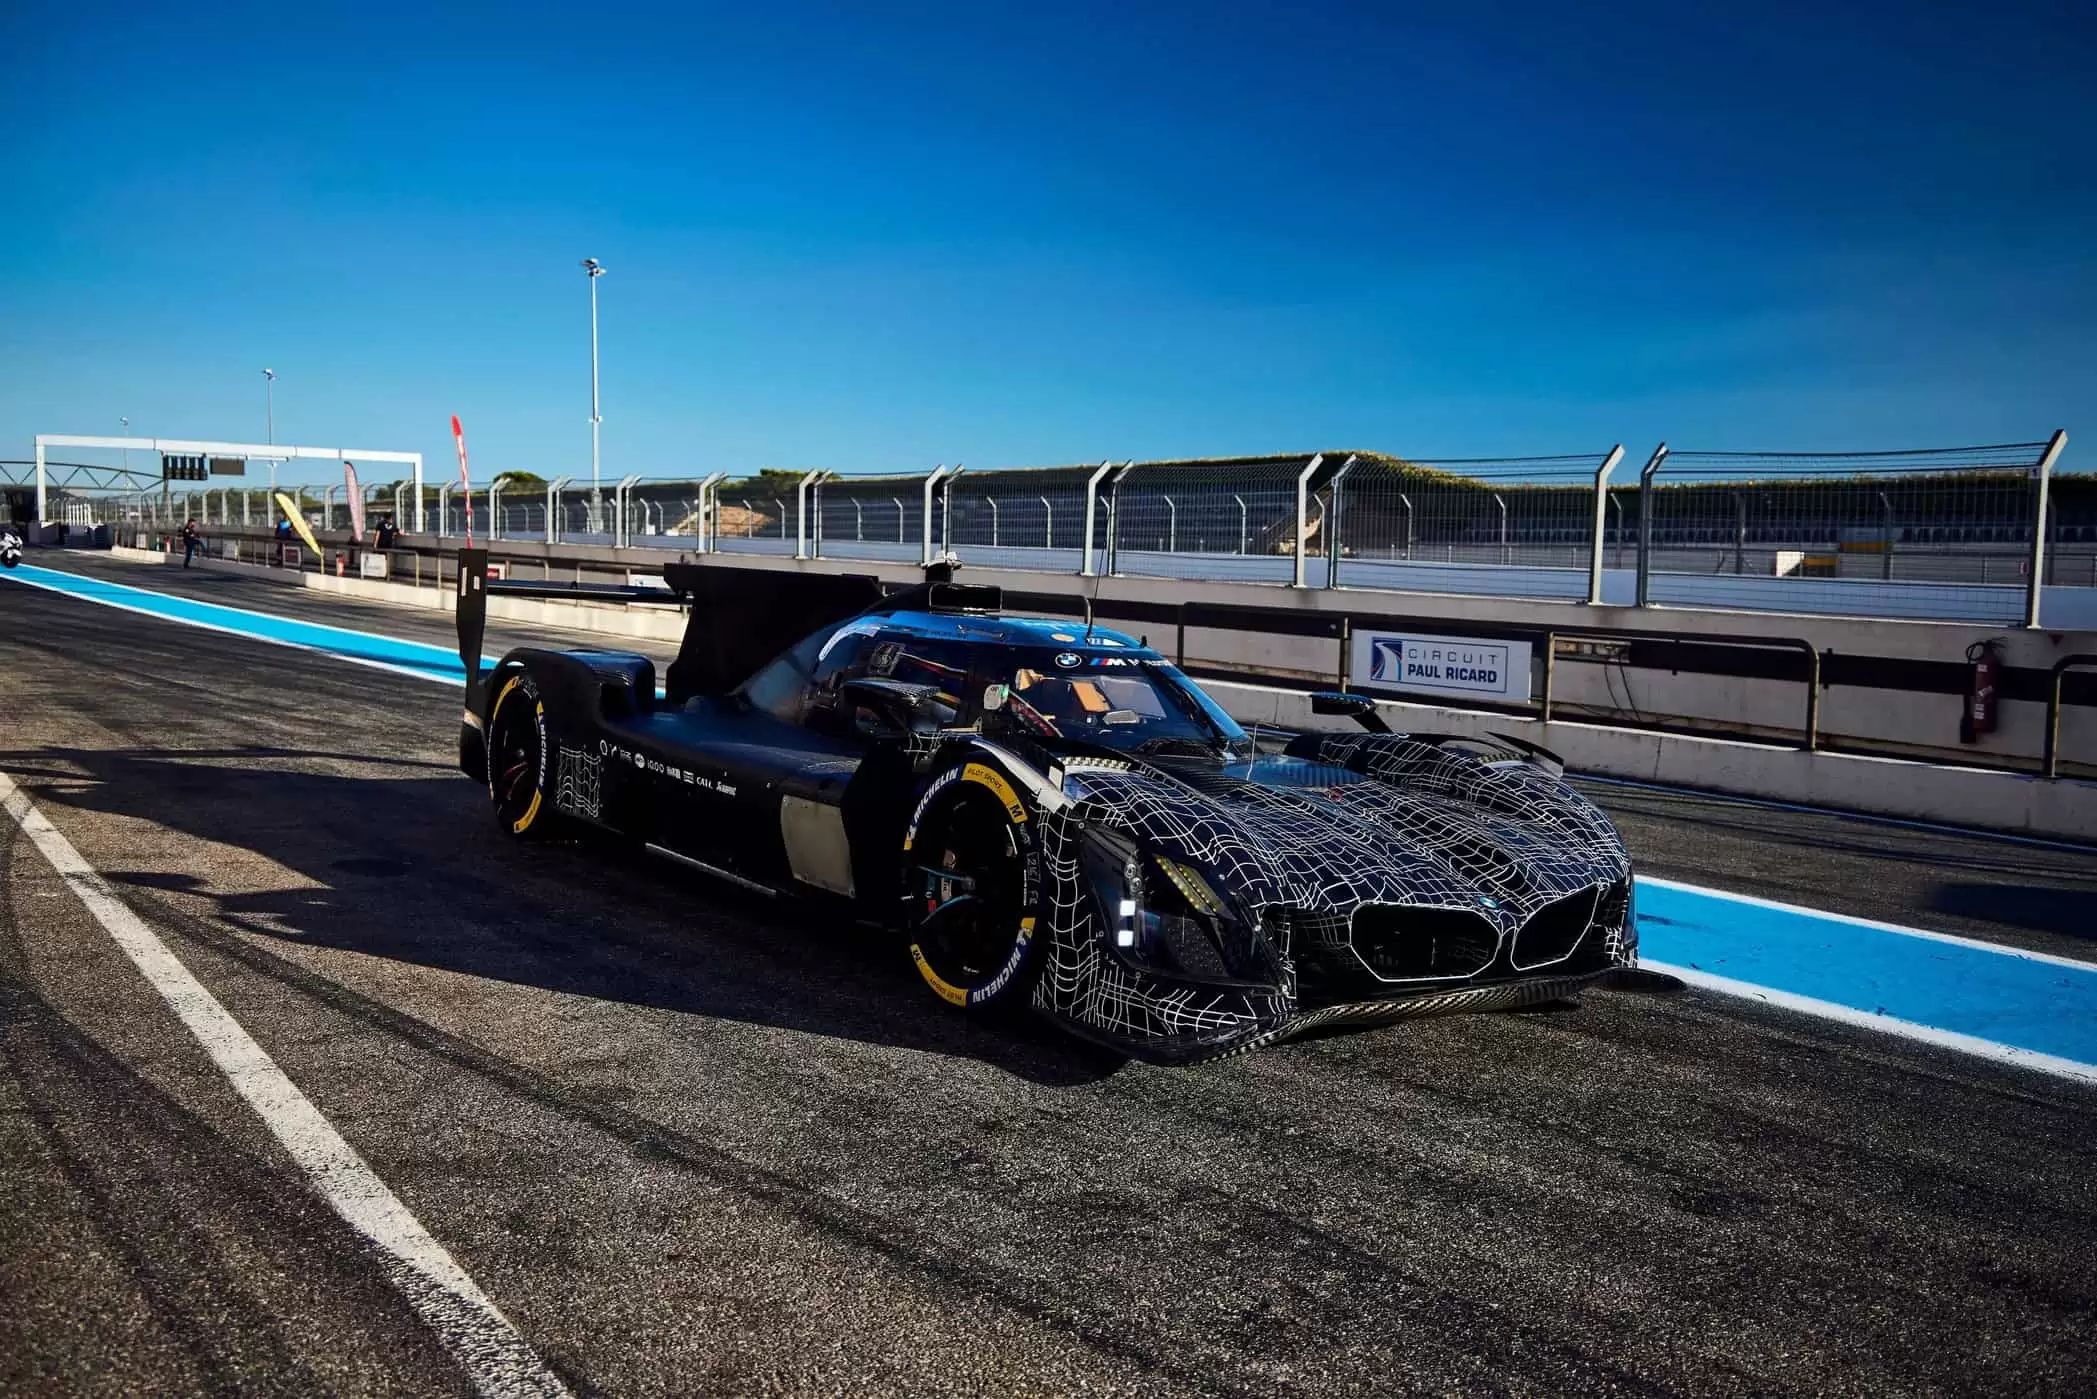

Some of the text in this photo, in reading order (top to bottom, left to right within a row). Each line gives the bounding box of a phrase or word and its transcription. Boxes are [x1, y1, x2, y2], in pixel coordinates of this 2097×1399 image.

[1408, 648, 1499, 665] CIRCUIT
[1408, 663, 1498, 684] PAUL RICARD
[914, 767, 959, 823] MICHELIN
[973, 947, 1021, 1003] MICHELIN
